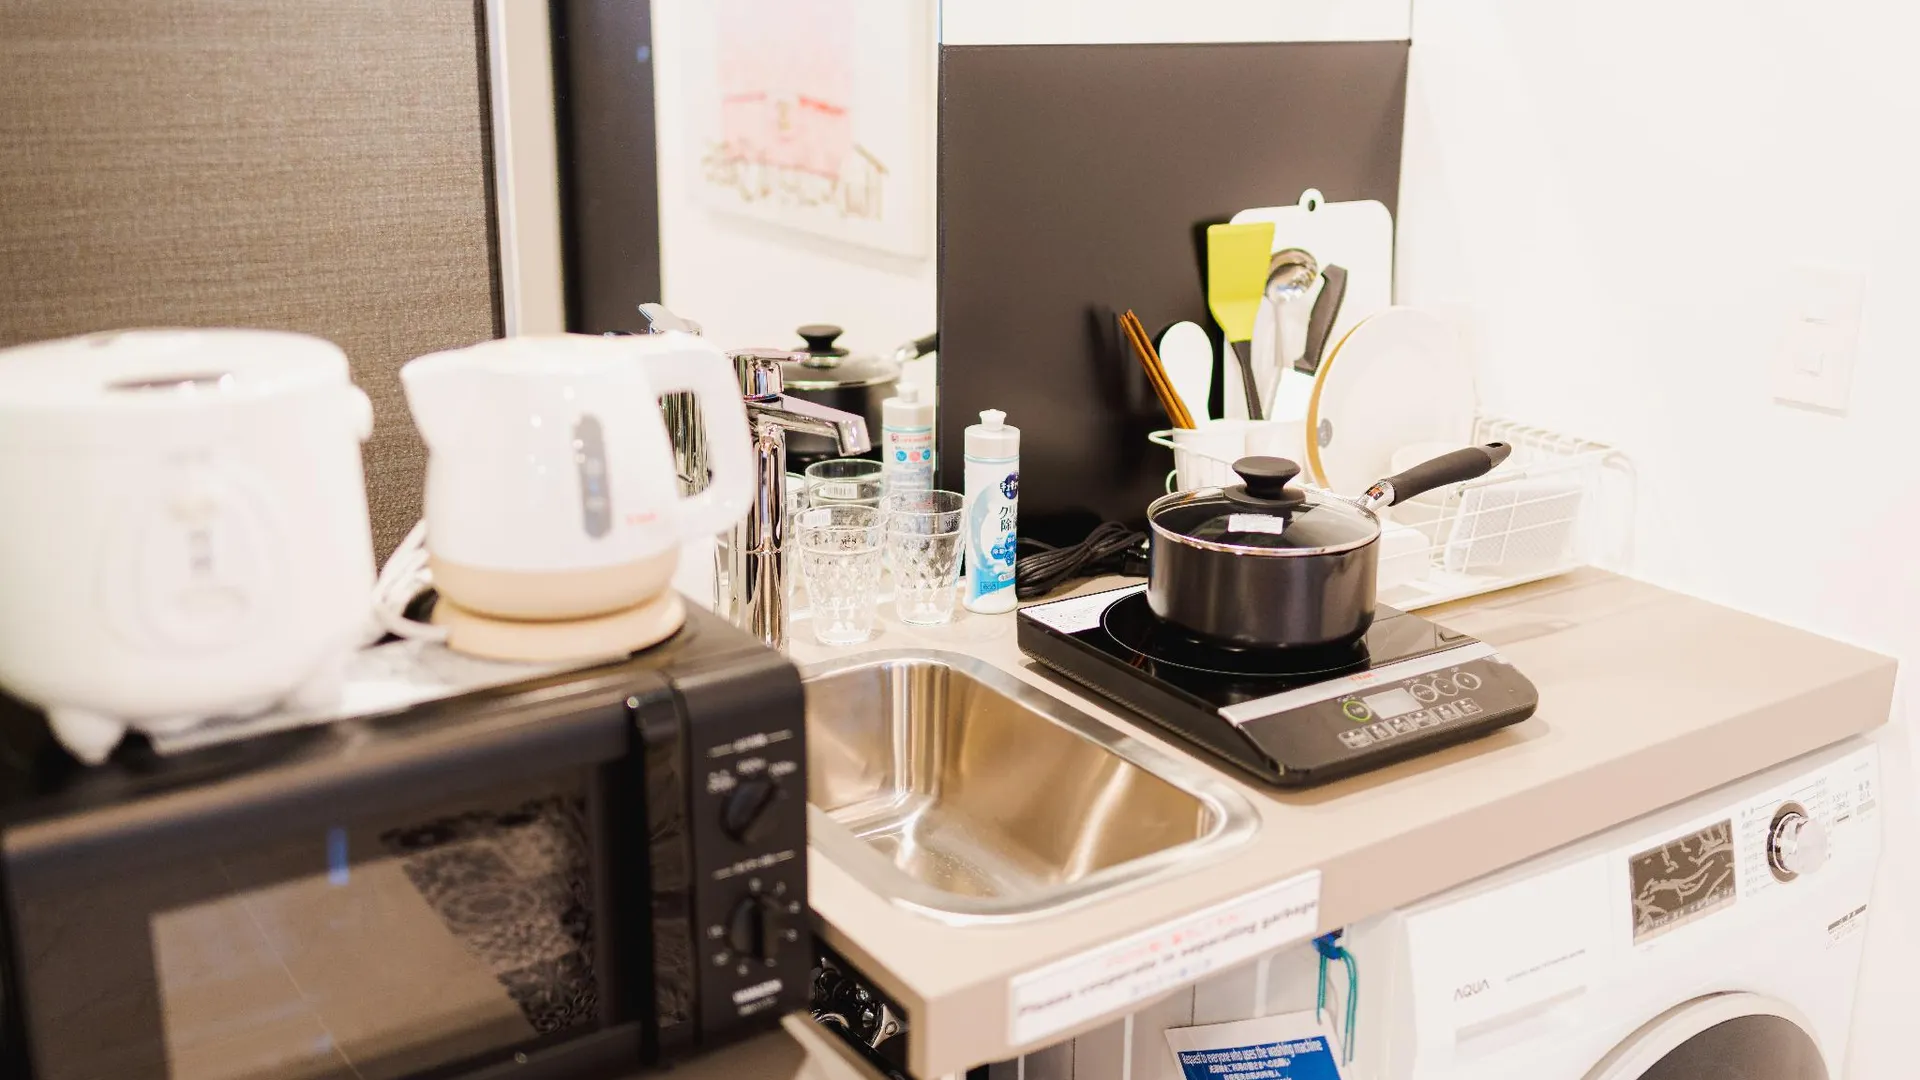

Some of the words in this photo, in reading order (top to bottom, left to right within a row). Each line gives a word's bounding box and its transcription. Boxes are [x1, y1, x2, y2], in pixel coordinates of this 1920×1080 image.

[1180, 920, 1257, 957] separating
[1261, 900, 1318, 929] garbage
[1453, 978, 1490, 1002] AQUA
[1207, 1053, 1231, 1066] everyone
[1243, 1049, 1257, 1060] uses
[1257, 1045, 1268, 1058] the
[1269, 1042, 1296, 1058] washing
[1296, 1039, 1322, 1053] machine
